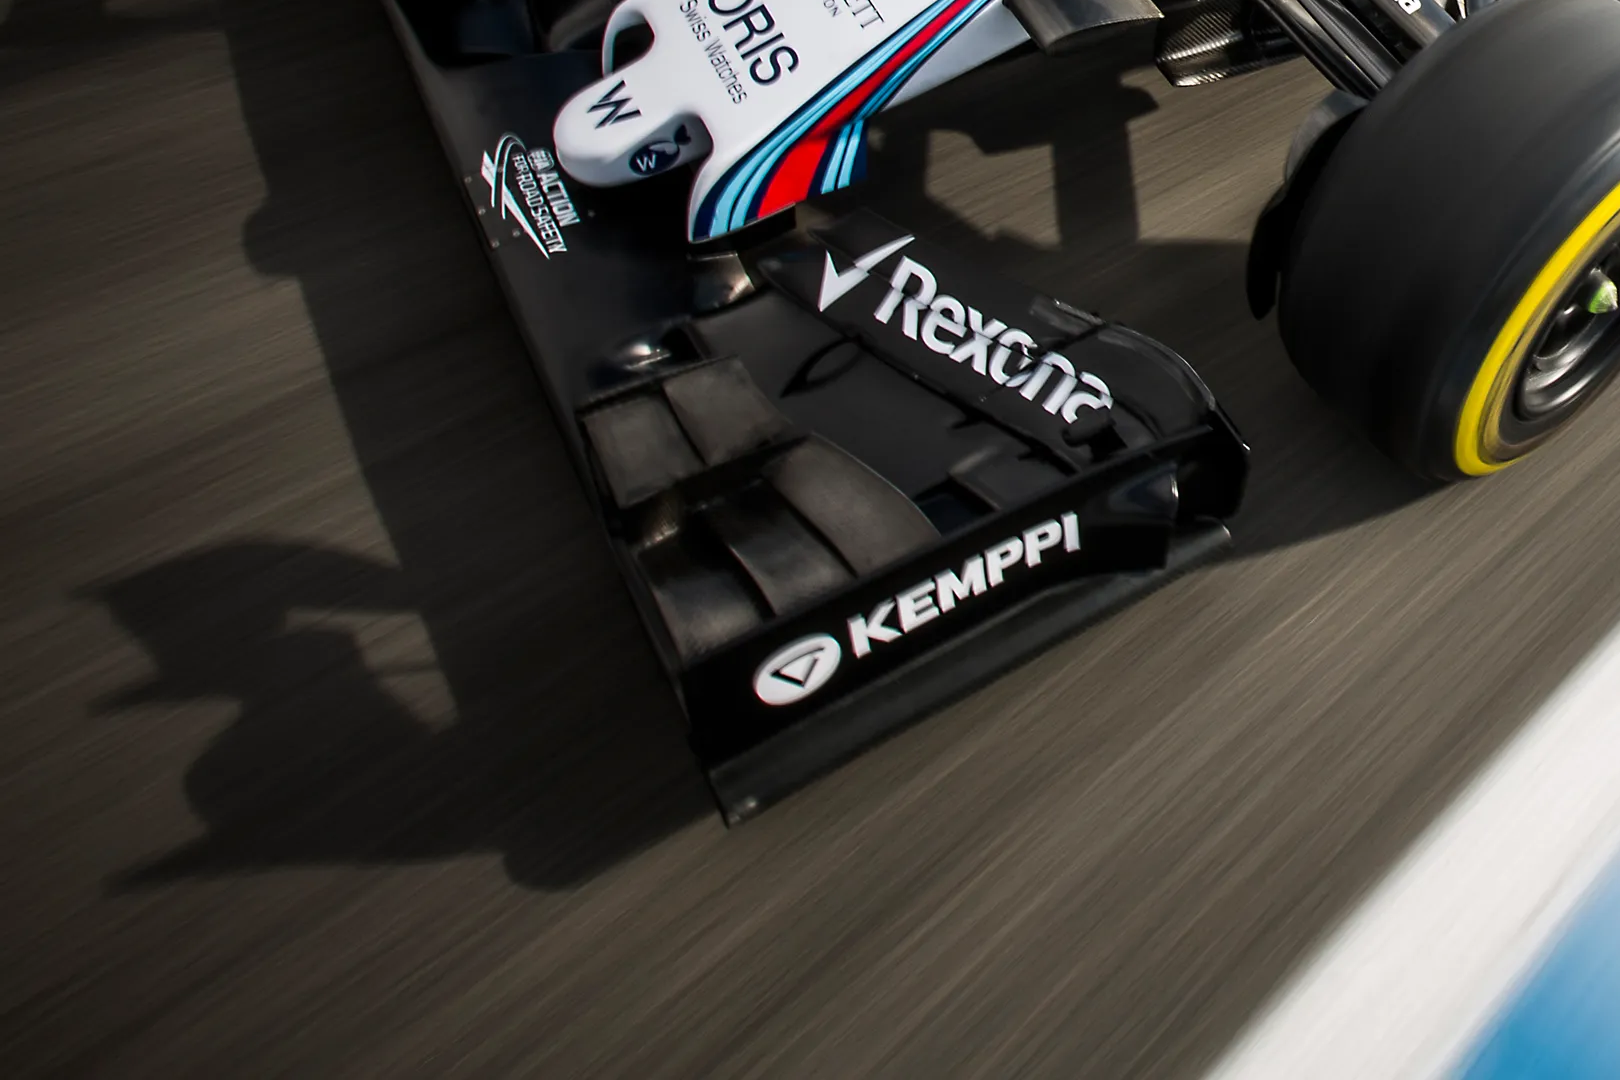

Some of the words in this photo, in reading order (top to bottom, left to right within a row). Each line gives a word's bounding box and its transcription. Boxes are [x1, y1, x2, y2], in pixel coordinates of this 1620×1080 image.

[703, 35, 748, 105] Watches
[515, 171, 545, 210] ROAD
[537, 170, 580, 228] ACTION
[529, 203, 568, 254] SAFETY
[874, 256, 1114, 424] Rexona
[846, 512, 1082, 658] KEMPPI
